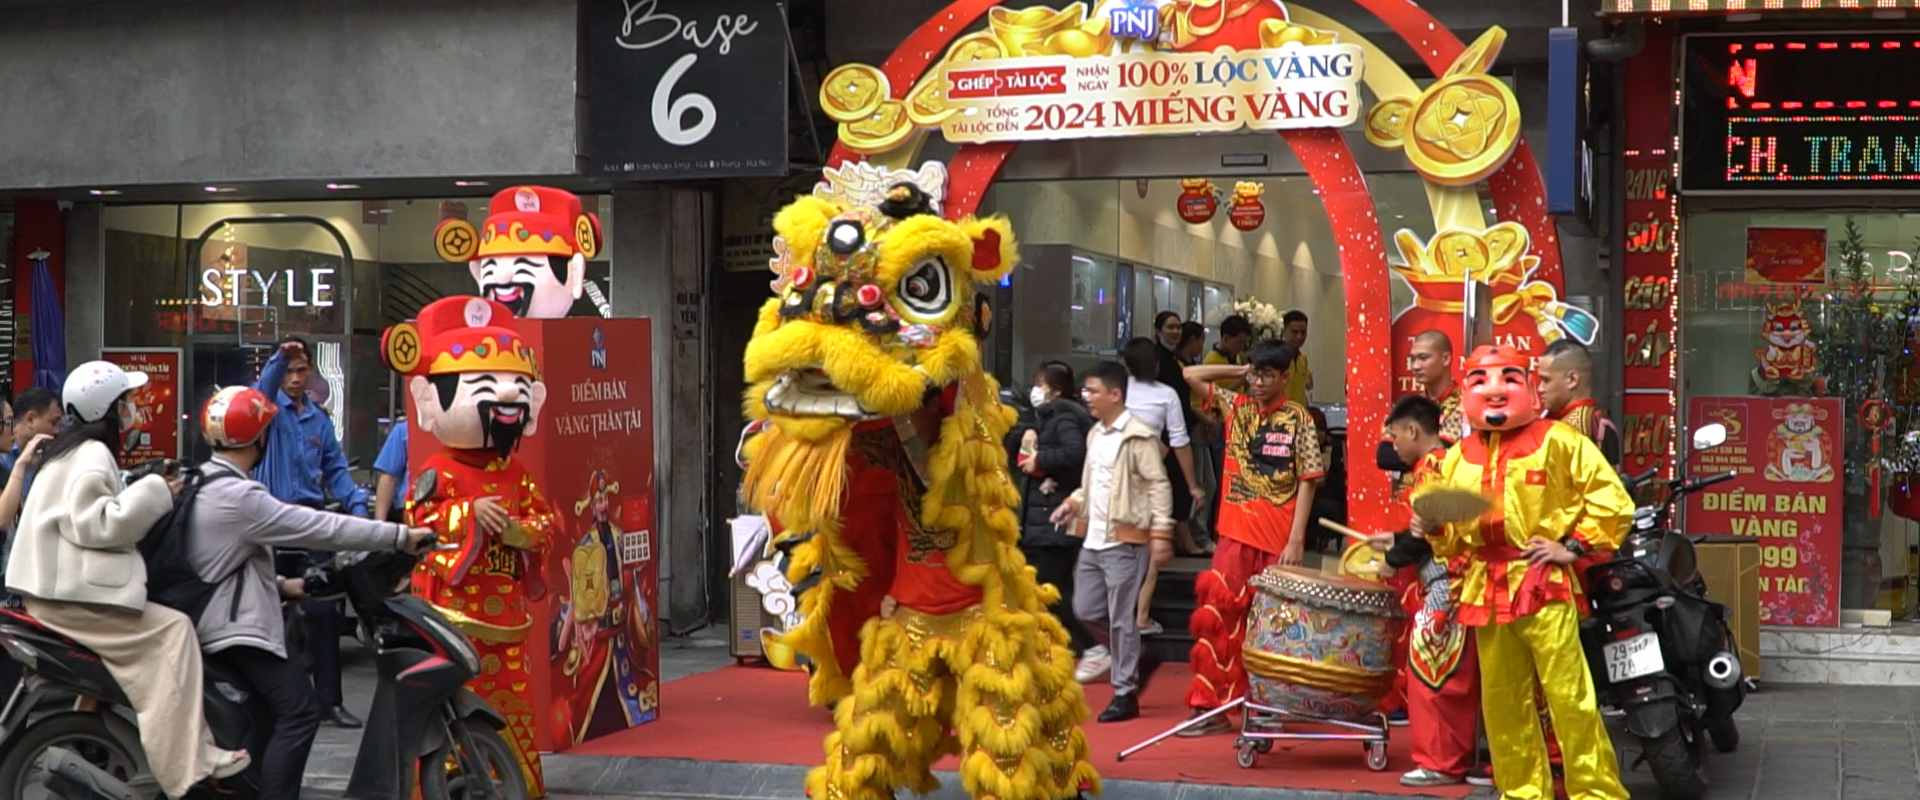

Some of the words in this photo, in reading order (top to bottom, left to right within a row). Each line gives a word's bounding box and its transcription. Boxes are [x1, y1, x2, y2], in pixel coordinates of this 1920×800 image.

[616, 0, 759, 54] Base
[1111, 8, 1155, 37] PNJ
[957, 75, 994, 91] GHÉP
[1006, 72, 1027, 88] TÀI
[1030, 71, 1058, 90] LỘC
[1077, 64, 1110, 80] NHẬN
[1118, 60, 1188, 88] 100%
[1195, 55, 1258, 88] LỘC
[1263, 52, 1354, 80] VÀNG
[651, 53, 717, 146] 6
[1024, 101, 1106, 131] 2024
[1112, 89, 1237, 127] MIẾNG
[1243, 86, 1349, 121] VÀNG
[952, 121, 968, 134] TÀI
[971, 120, 994, 135] LỘC
[996, 117, 1019, 133] ĐẾN
[201, 267, 336, 308] STYLE
[604, 377, 627, 401] BÁN
[555, 412, 590, 436] VÀNG
[590, 410, 622, 439] THẦN
[624, 406, 642, 436] TÀI
[1702, 486, 1767, 513] ĐIỂM
[1774, 491, 1827, 514] BÁN
[1730, 514, 1798, 538] VÀNG
